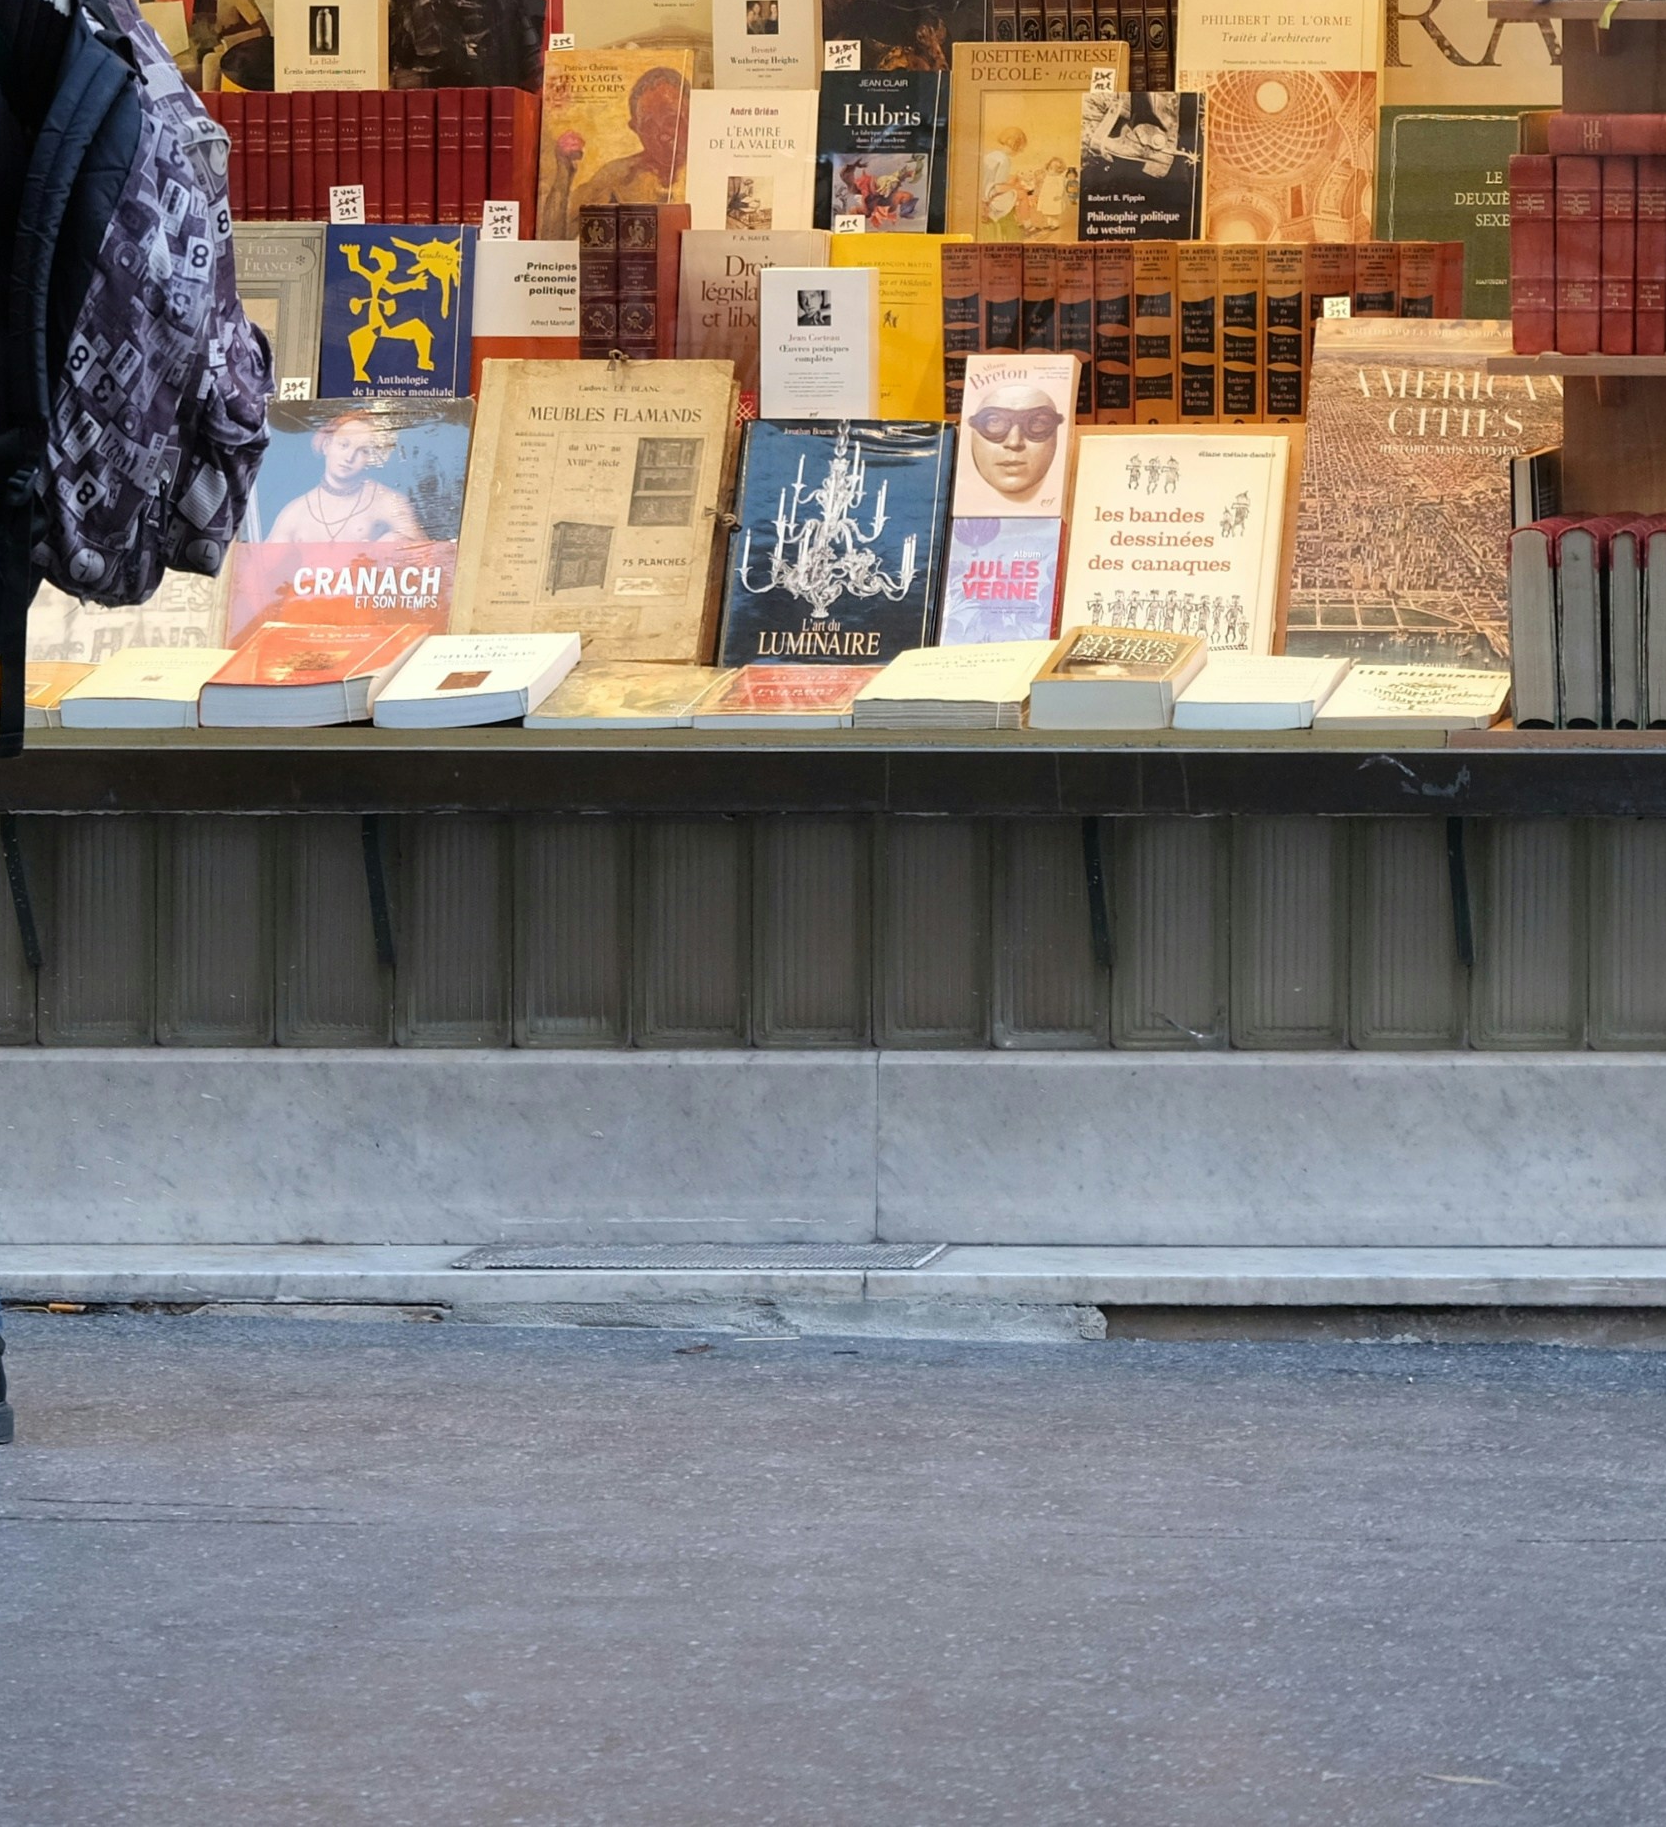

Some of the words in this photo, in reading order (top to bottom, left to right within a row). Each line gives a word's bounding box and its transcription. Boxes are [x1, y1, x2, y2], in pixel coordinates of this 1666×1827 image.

[1201, 15, 1271, 26] PHILIBERT
[1278, 16, 1296, 25] DE
[1302, 15, 1352, 26] L'ORME
[858, 78, 879, 88] JEAN
[881, 78, 909, 88] CLAIR
[843, 104, 922, 127] Hubris
[726, 125, 781, 138] L'EMPIRE
[1486, 172, 1502, 184] LE
[1087, 211, 1138, 224] Philosophie
[1140, 211, 1180, 224] politique
[1475, 214, 1510, 227] SEXE
[1087, 224, 1099, 235] du
[1101, 225, 1136, 235] western
[244, 257, 295, 271] FRANCE
[526, 262, 577, 272] Principes
[514, 273, 577, 283] d'Économie
[529, 286, 576, 297] politique
[795, 354, 833, 364] complètes
[377, 375, 429, 386] Anthologie
[969, 367, 1028, 390] Breton
[528, 406, 606, 423] MEUBLES
[613, 407, 702, 422] FLAMANDS
[1388, 408, 1524, 439] CITIES
[1095, 507, 1125, 523] les
[1129, 506, 1205, 524] bandes
[1109, 531, 1214, 549] dessinées
[622, 558, 634, 566] 75
[638, 557, 687, 566] PLANCHES
[1088, 555, 1124, 572] des
[1131, 557, 1231, 577] canaques
[964, 560, 1040, 579] JULES
[293, 566, 441, 596] CRANACH
[962, 582, 1037, 600] VERNE
[355, 596, 369, 609] ET
[372, 596, 397, 609] SON
[400, 596, 438, 609] TEMPS
[757, 632, 880, 655] LUMINAIRE
